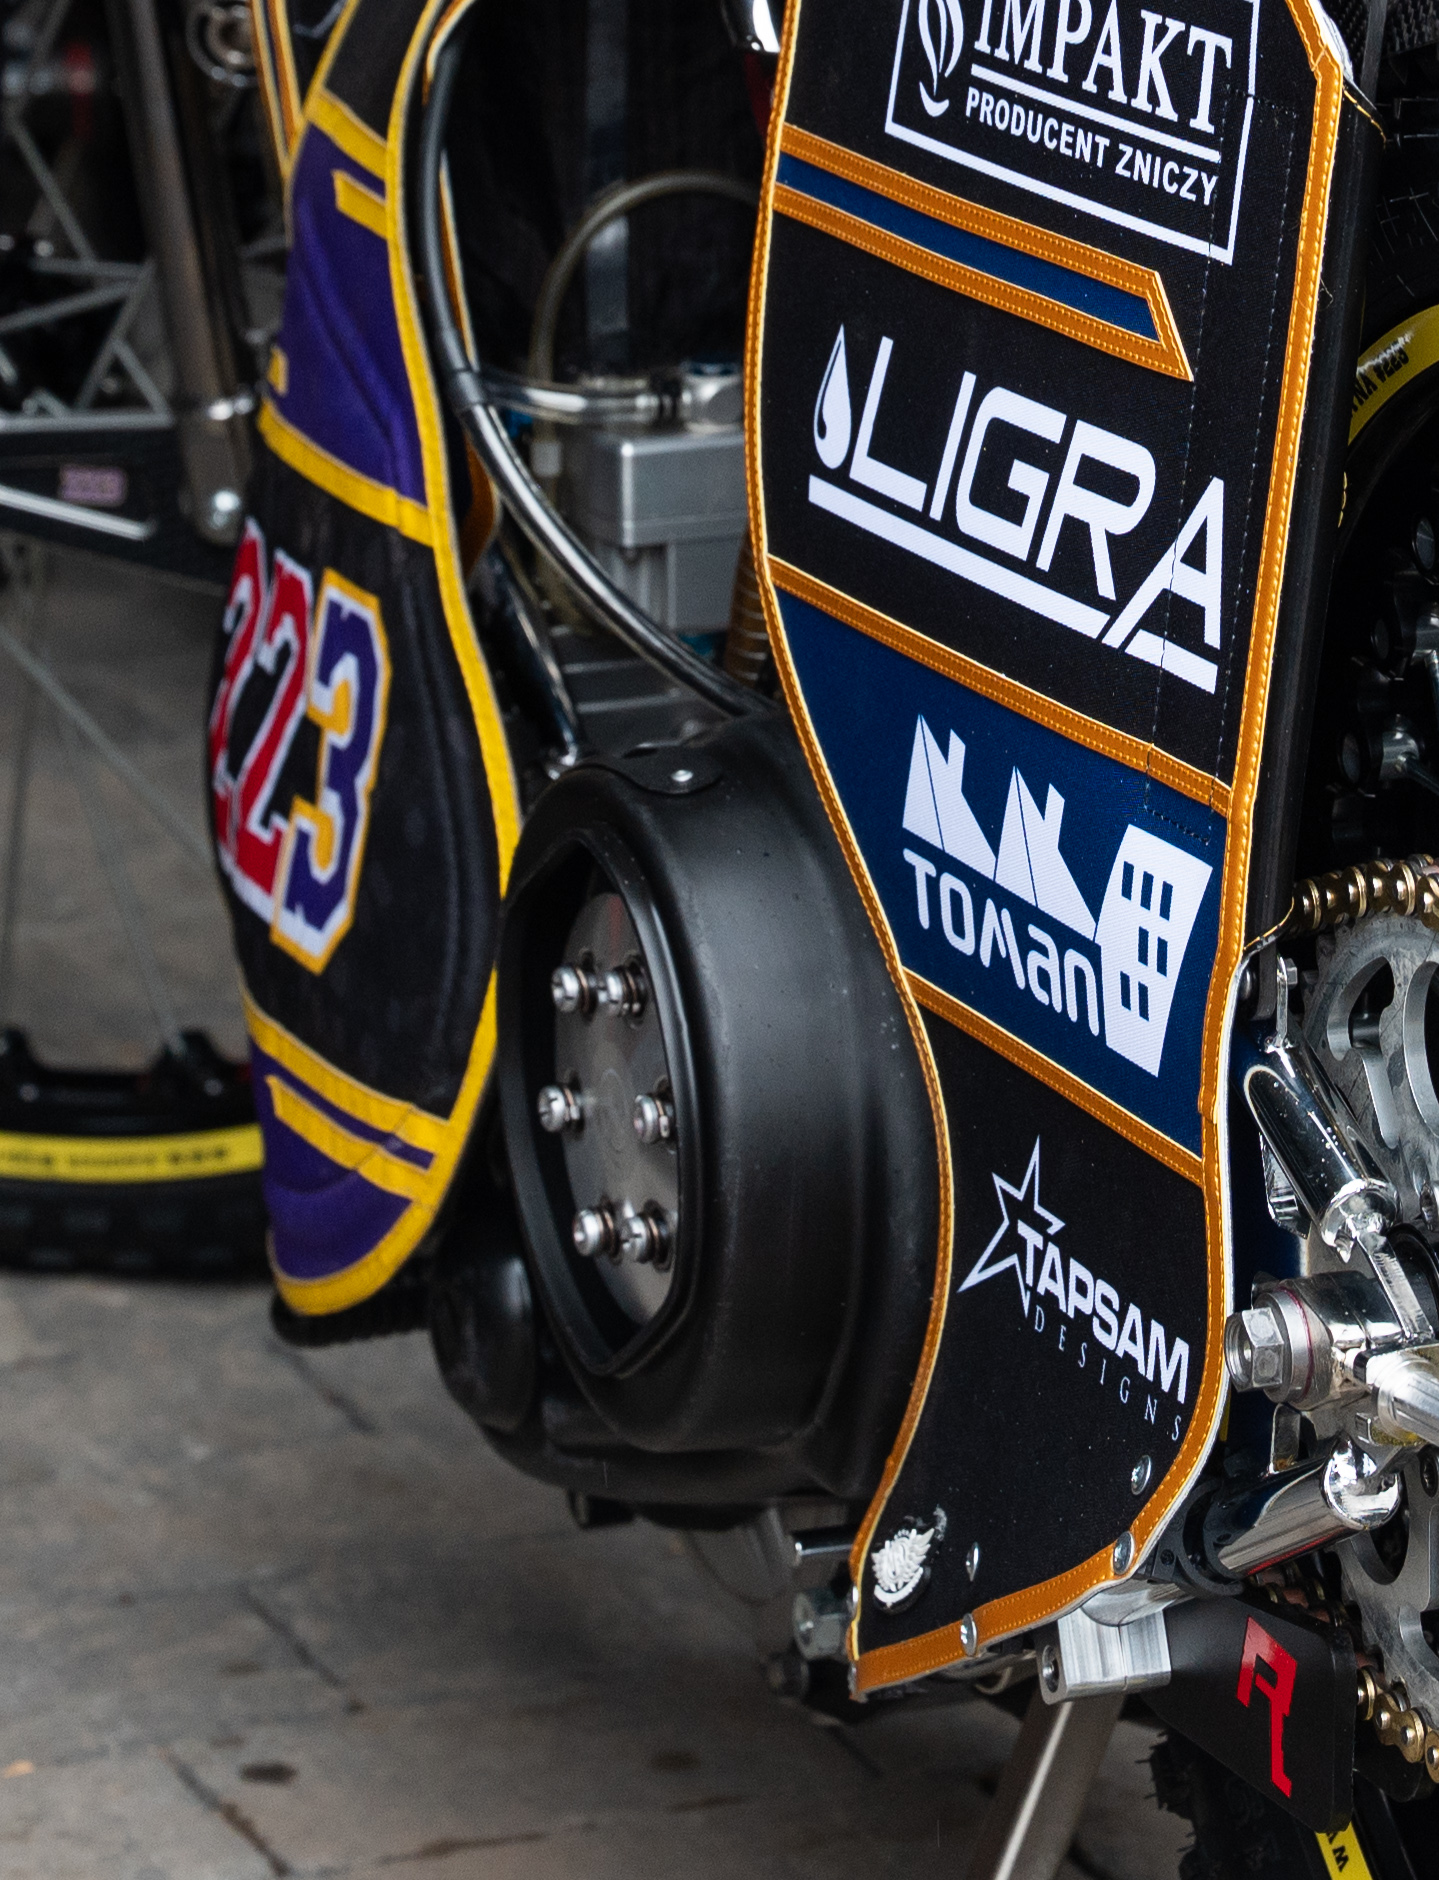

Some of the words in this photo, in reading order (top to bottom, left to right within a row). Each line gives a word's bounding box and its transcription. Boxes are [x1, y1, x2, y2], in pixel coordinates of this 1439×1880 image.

[966, 85, 1113, 169] PRODUCENT
[1114, 140, 1219, 207] ZNICZY
[849, 335, 1225, 651] LIGRA
[1017, 1221, 1190, 1404] TAPSAM
[1033, 1305, 1183, 1442] DESIGNS
